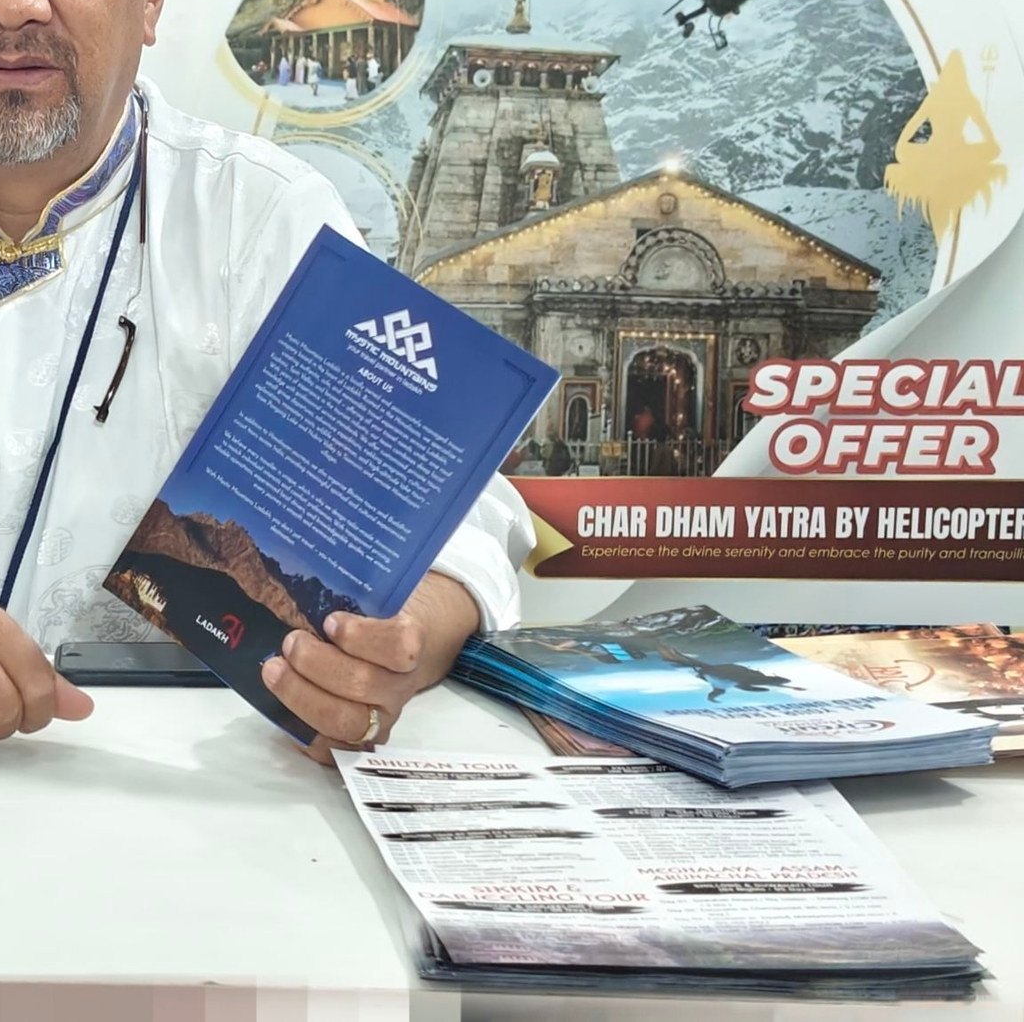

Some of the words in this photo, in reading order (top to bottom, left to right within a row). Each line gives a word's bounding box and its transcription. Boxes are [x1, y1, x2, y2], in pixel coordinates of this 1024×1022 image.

[358, 367, 382, 386] ABOUT
[381, 382, 393, 393] US
[748, 362, 1024, 409] SPECIAL
[773, 423, 991, 467] OFFER
[578, 505, 648, 538] CHAR
[655, 505, 736, 538] DHAM
[744, 505, 827, 539] YATRA
[835, 506, 870, 539] BY
[582, 545, 655, 559] Experience
[659, 545, 679, 557] the
[682, 545, 722, 558] divine
[725, 545, 776, 560] serenity
[778, 546, 806, 558] and
[808, 546, 870, 559] embrace
[874, 546, 895, 559] the
[898, 547, 935, 561] purity
[939, 547, 966, 559] and
[195, 614, 230, 644] LADAKH
[367, 758, 453, 770] BHUTAN
[459, 762, 519, 771] TOUR
[637, 865, 753, 875] MEGHALAYA
[779, 865, 844, 873] ASSAM
[653, 873, 767, 882] ARUNACHAL
[771, 872, 858, 880] PRADESH
[472, 884, 558, 894] SIKKIM
[584, 892, 650, 903] TOUR
